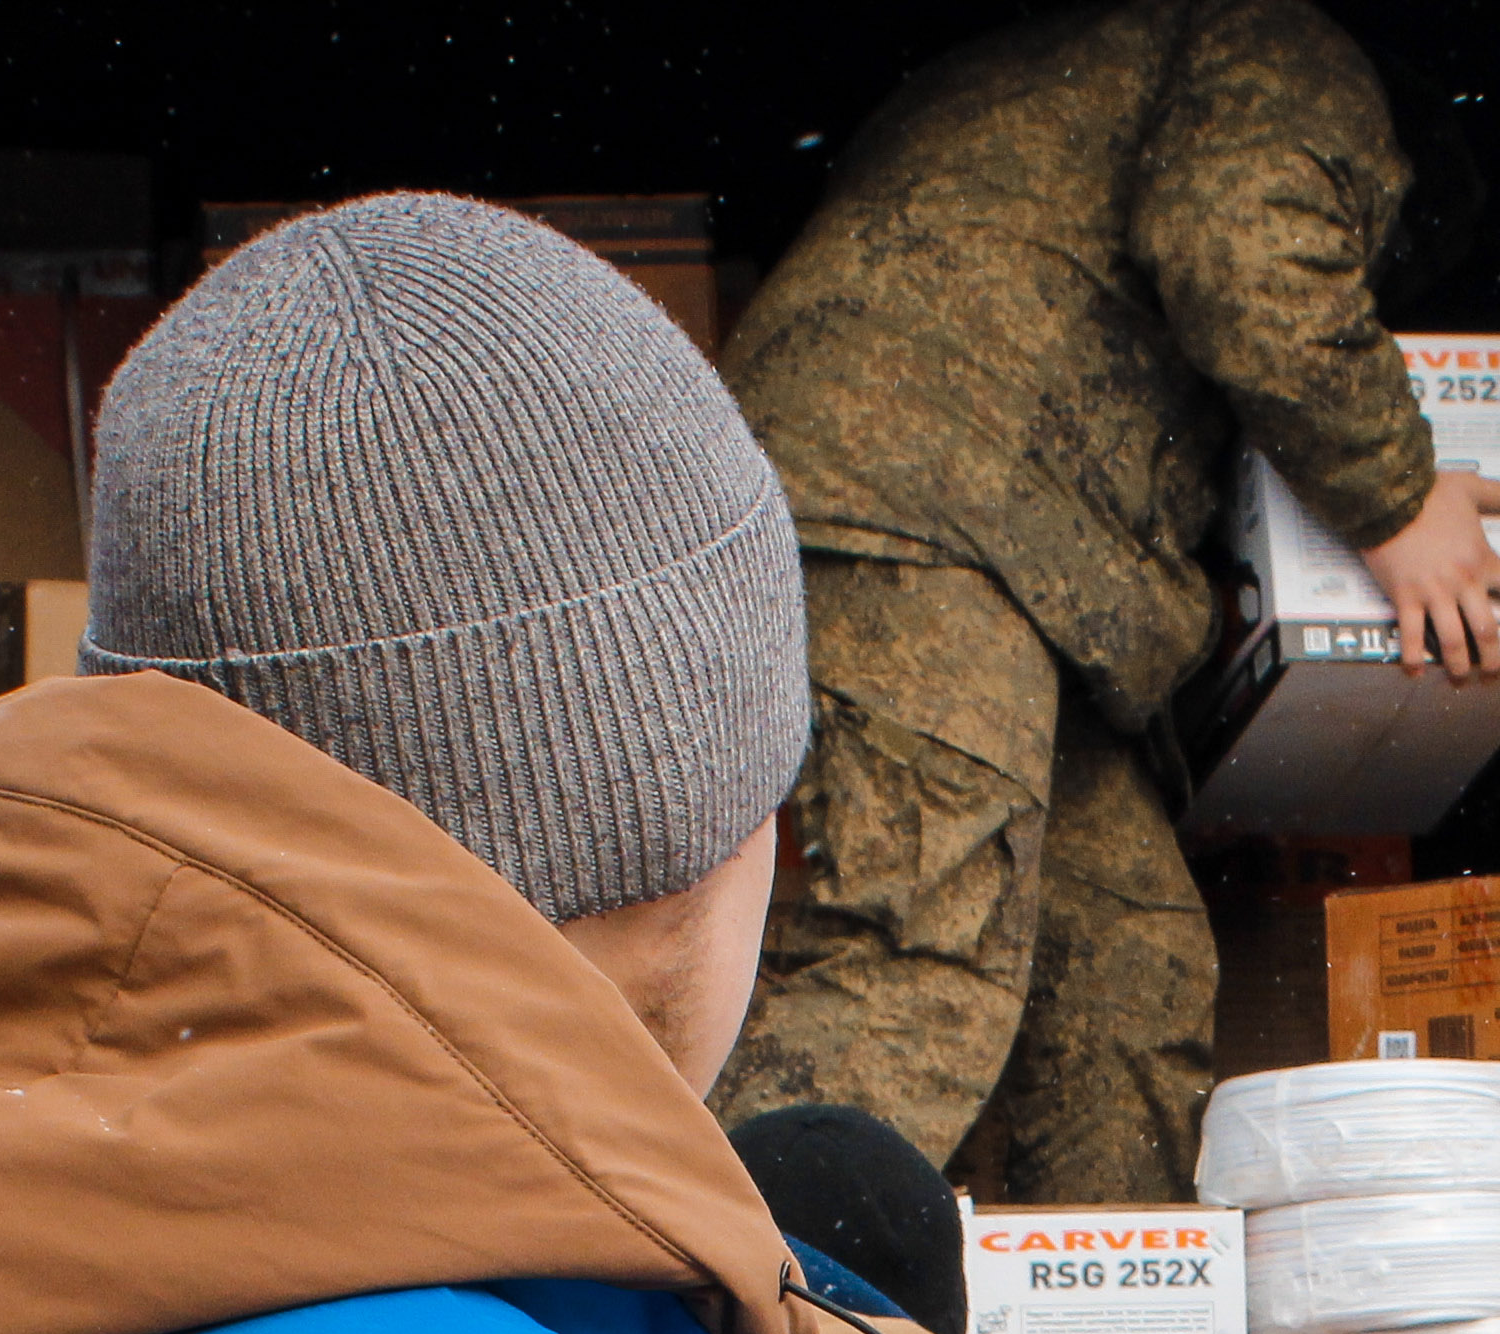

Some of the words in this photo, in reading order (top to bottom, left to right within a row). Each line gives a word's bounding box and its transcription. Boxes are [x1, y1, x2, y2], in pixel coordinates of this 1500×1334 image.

[978, 1227, 1212, 1253] CARVER
[1029, 1259, 1106, 1289] RSG
[1118, 1258, 1213, 1288] 252X
